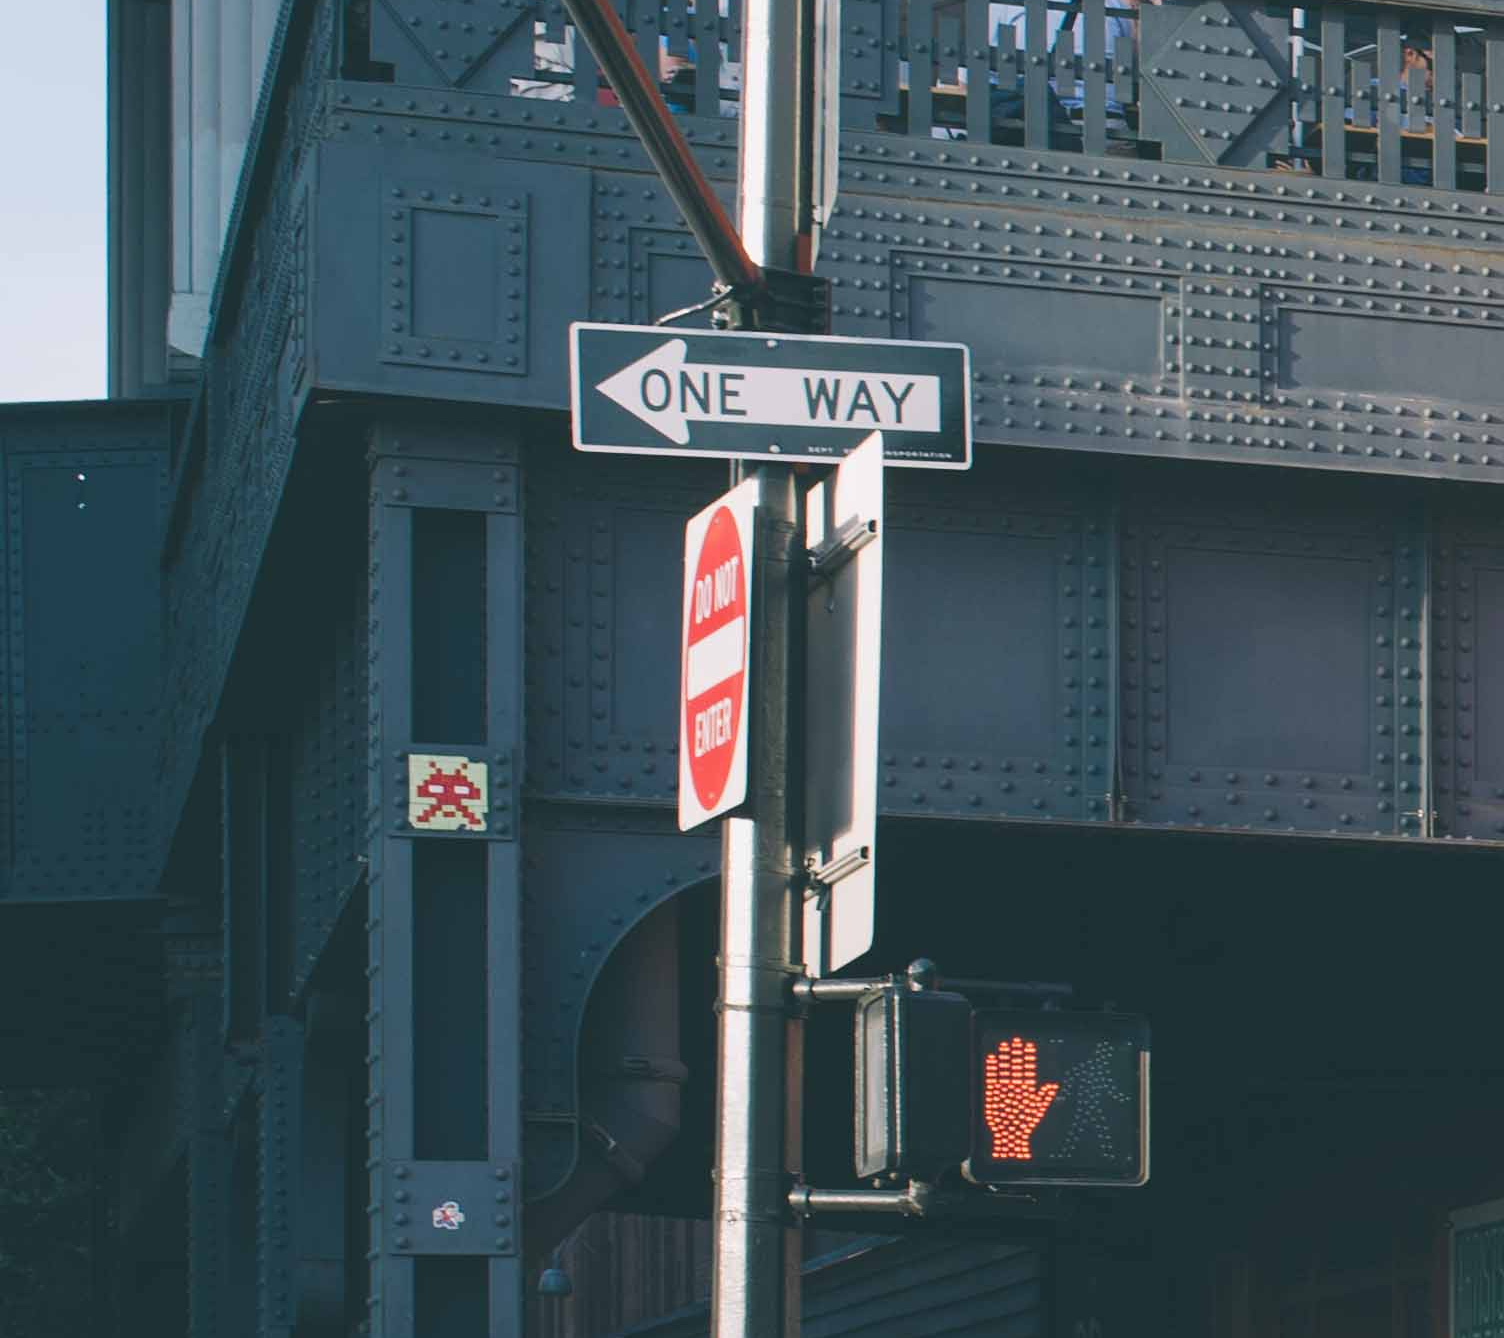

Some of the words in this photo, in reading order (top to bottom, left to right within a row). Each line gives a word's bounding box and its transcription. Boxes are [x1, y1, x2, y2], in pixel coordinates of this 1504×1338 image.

[640, 368, 747, 416] ONE
[803, 377, 915, 424] WAY
[695, 573, 713, 624] DO
[713, 555, 739, 612] NOT
[694, 696, 733, 758] ENTER
